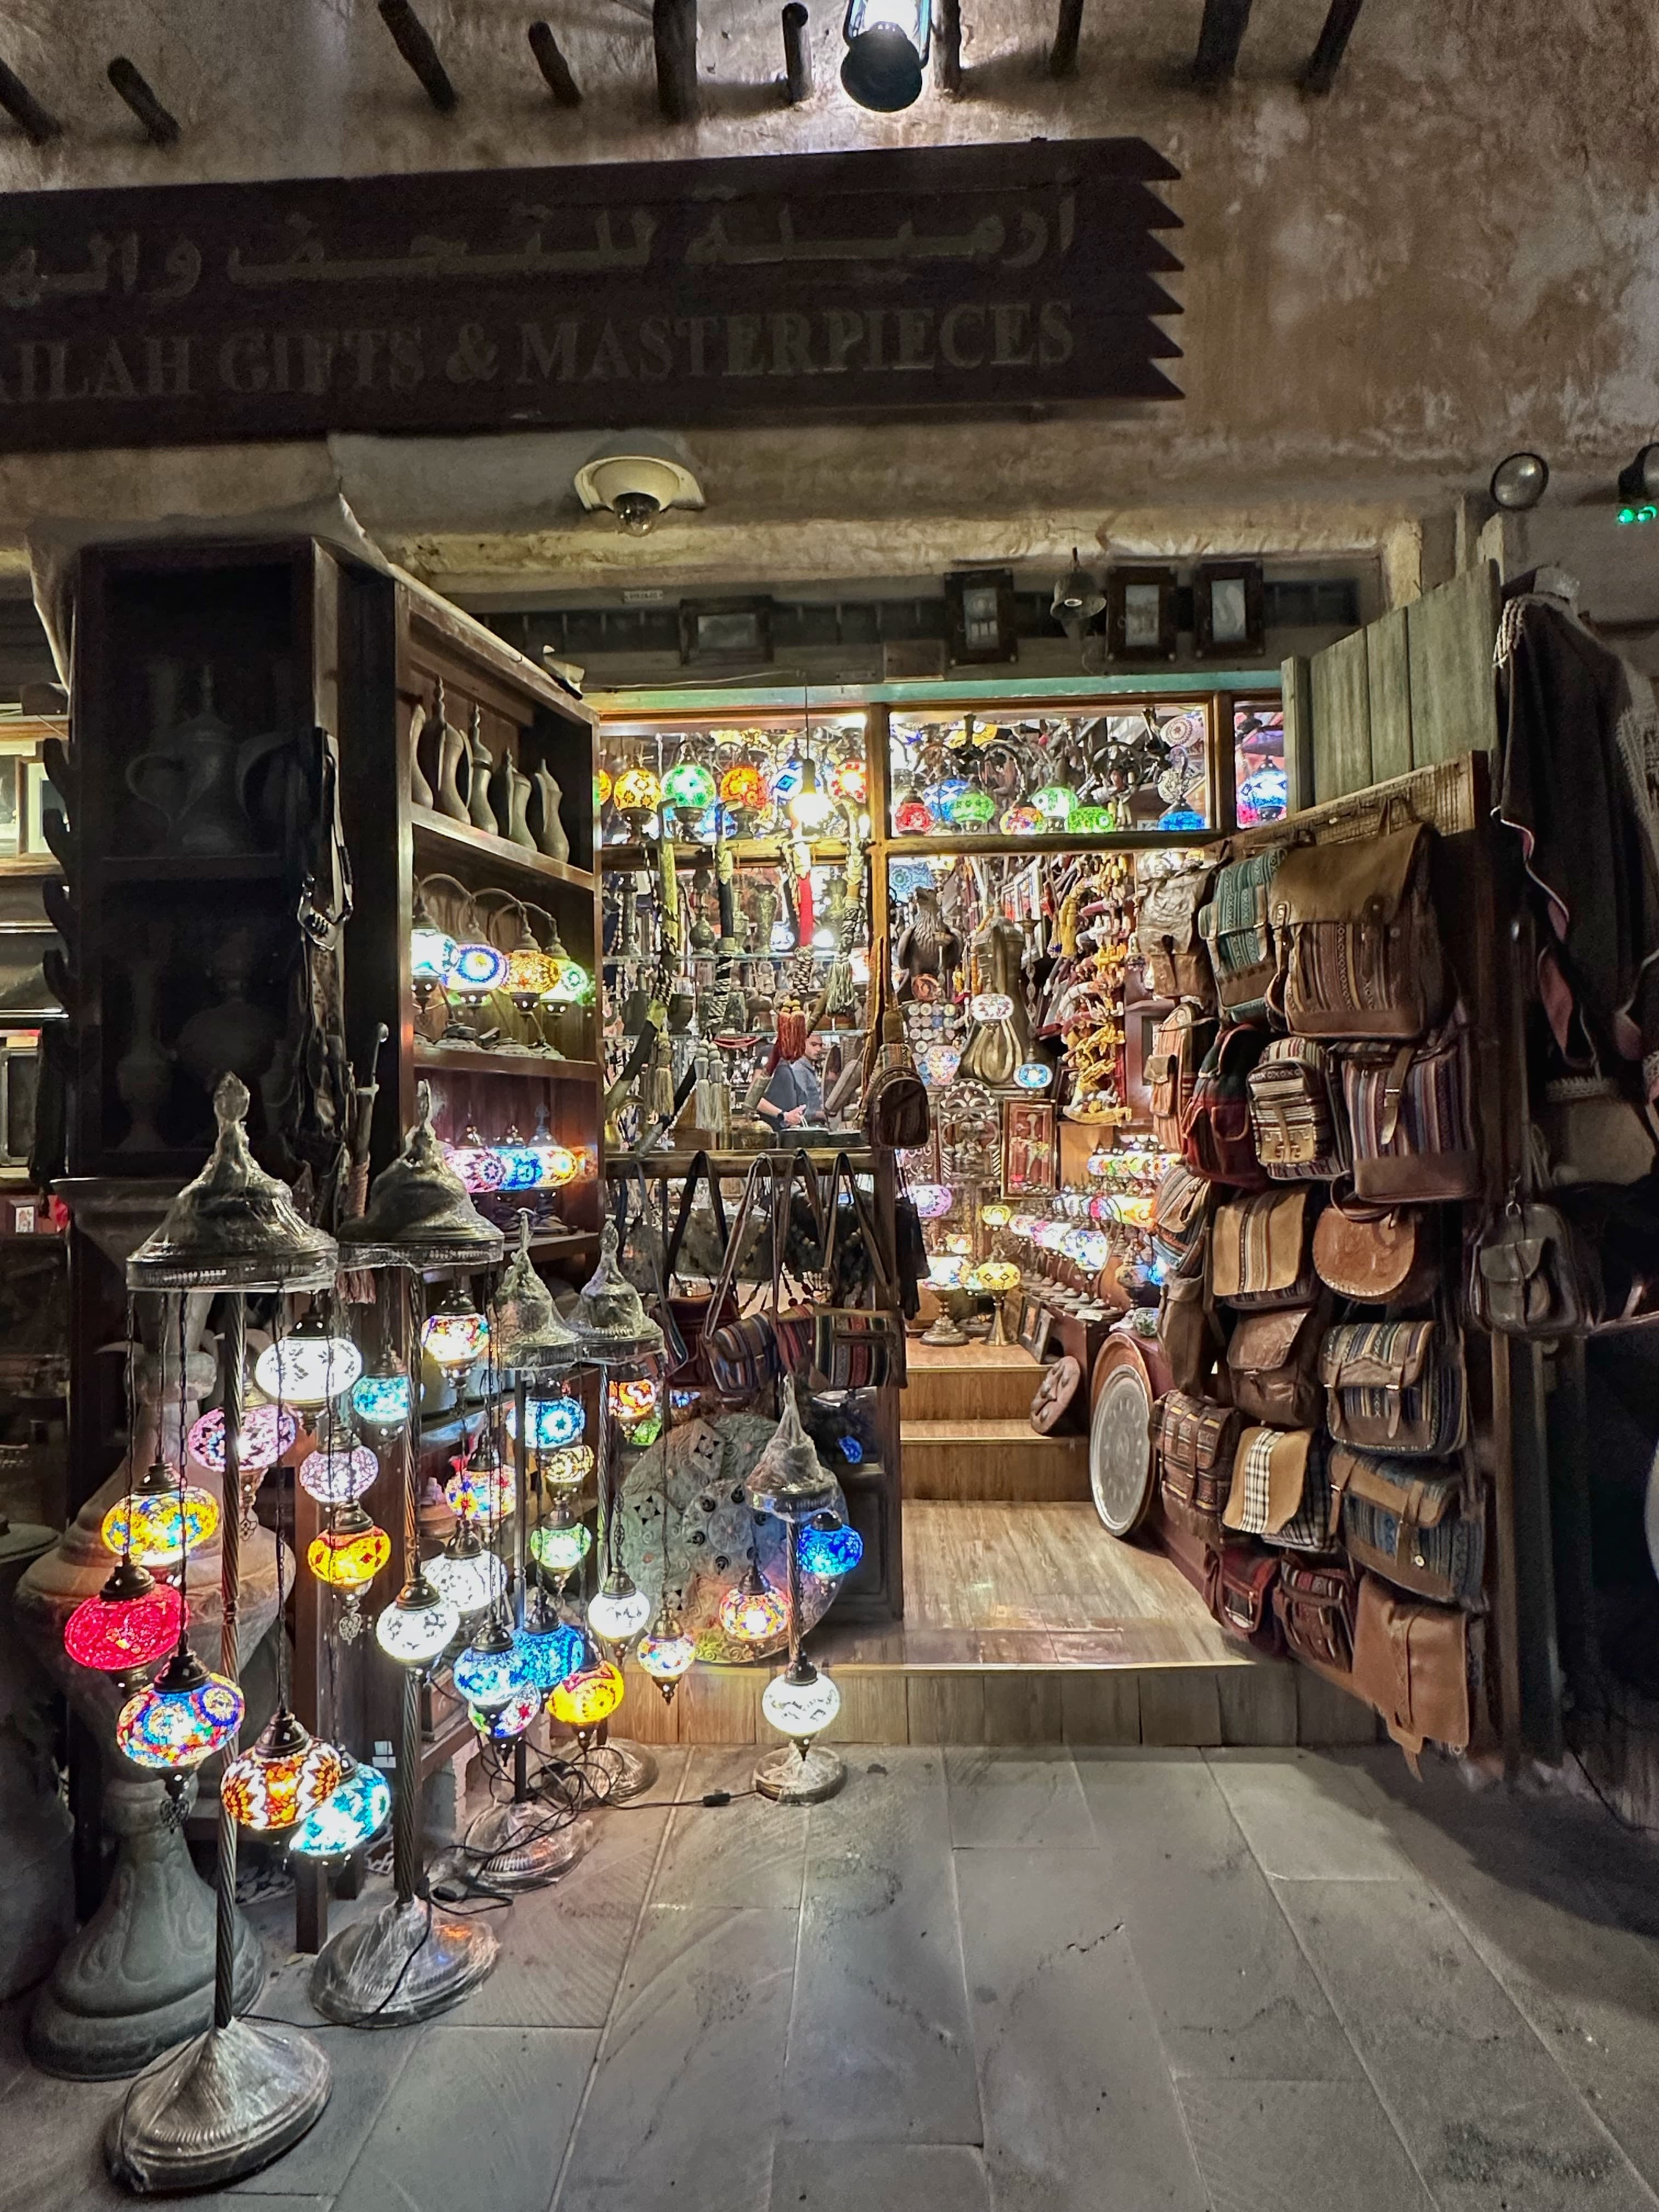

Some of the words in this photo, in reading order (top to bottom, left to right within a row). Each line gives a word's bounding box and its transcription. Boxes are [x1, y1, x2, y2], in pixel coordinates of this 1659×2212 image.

[0, 229, 201, 307] واله
[227, 202, 658, 284] للتحف
[0, 334, 196, 402] ILAH
[219, 325, 424, 395] GIFTS
[445, 323, 498, 383] &
[516, 300, 1074, 383] MASTERPIECES
